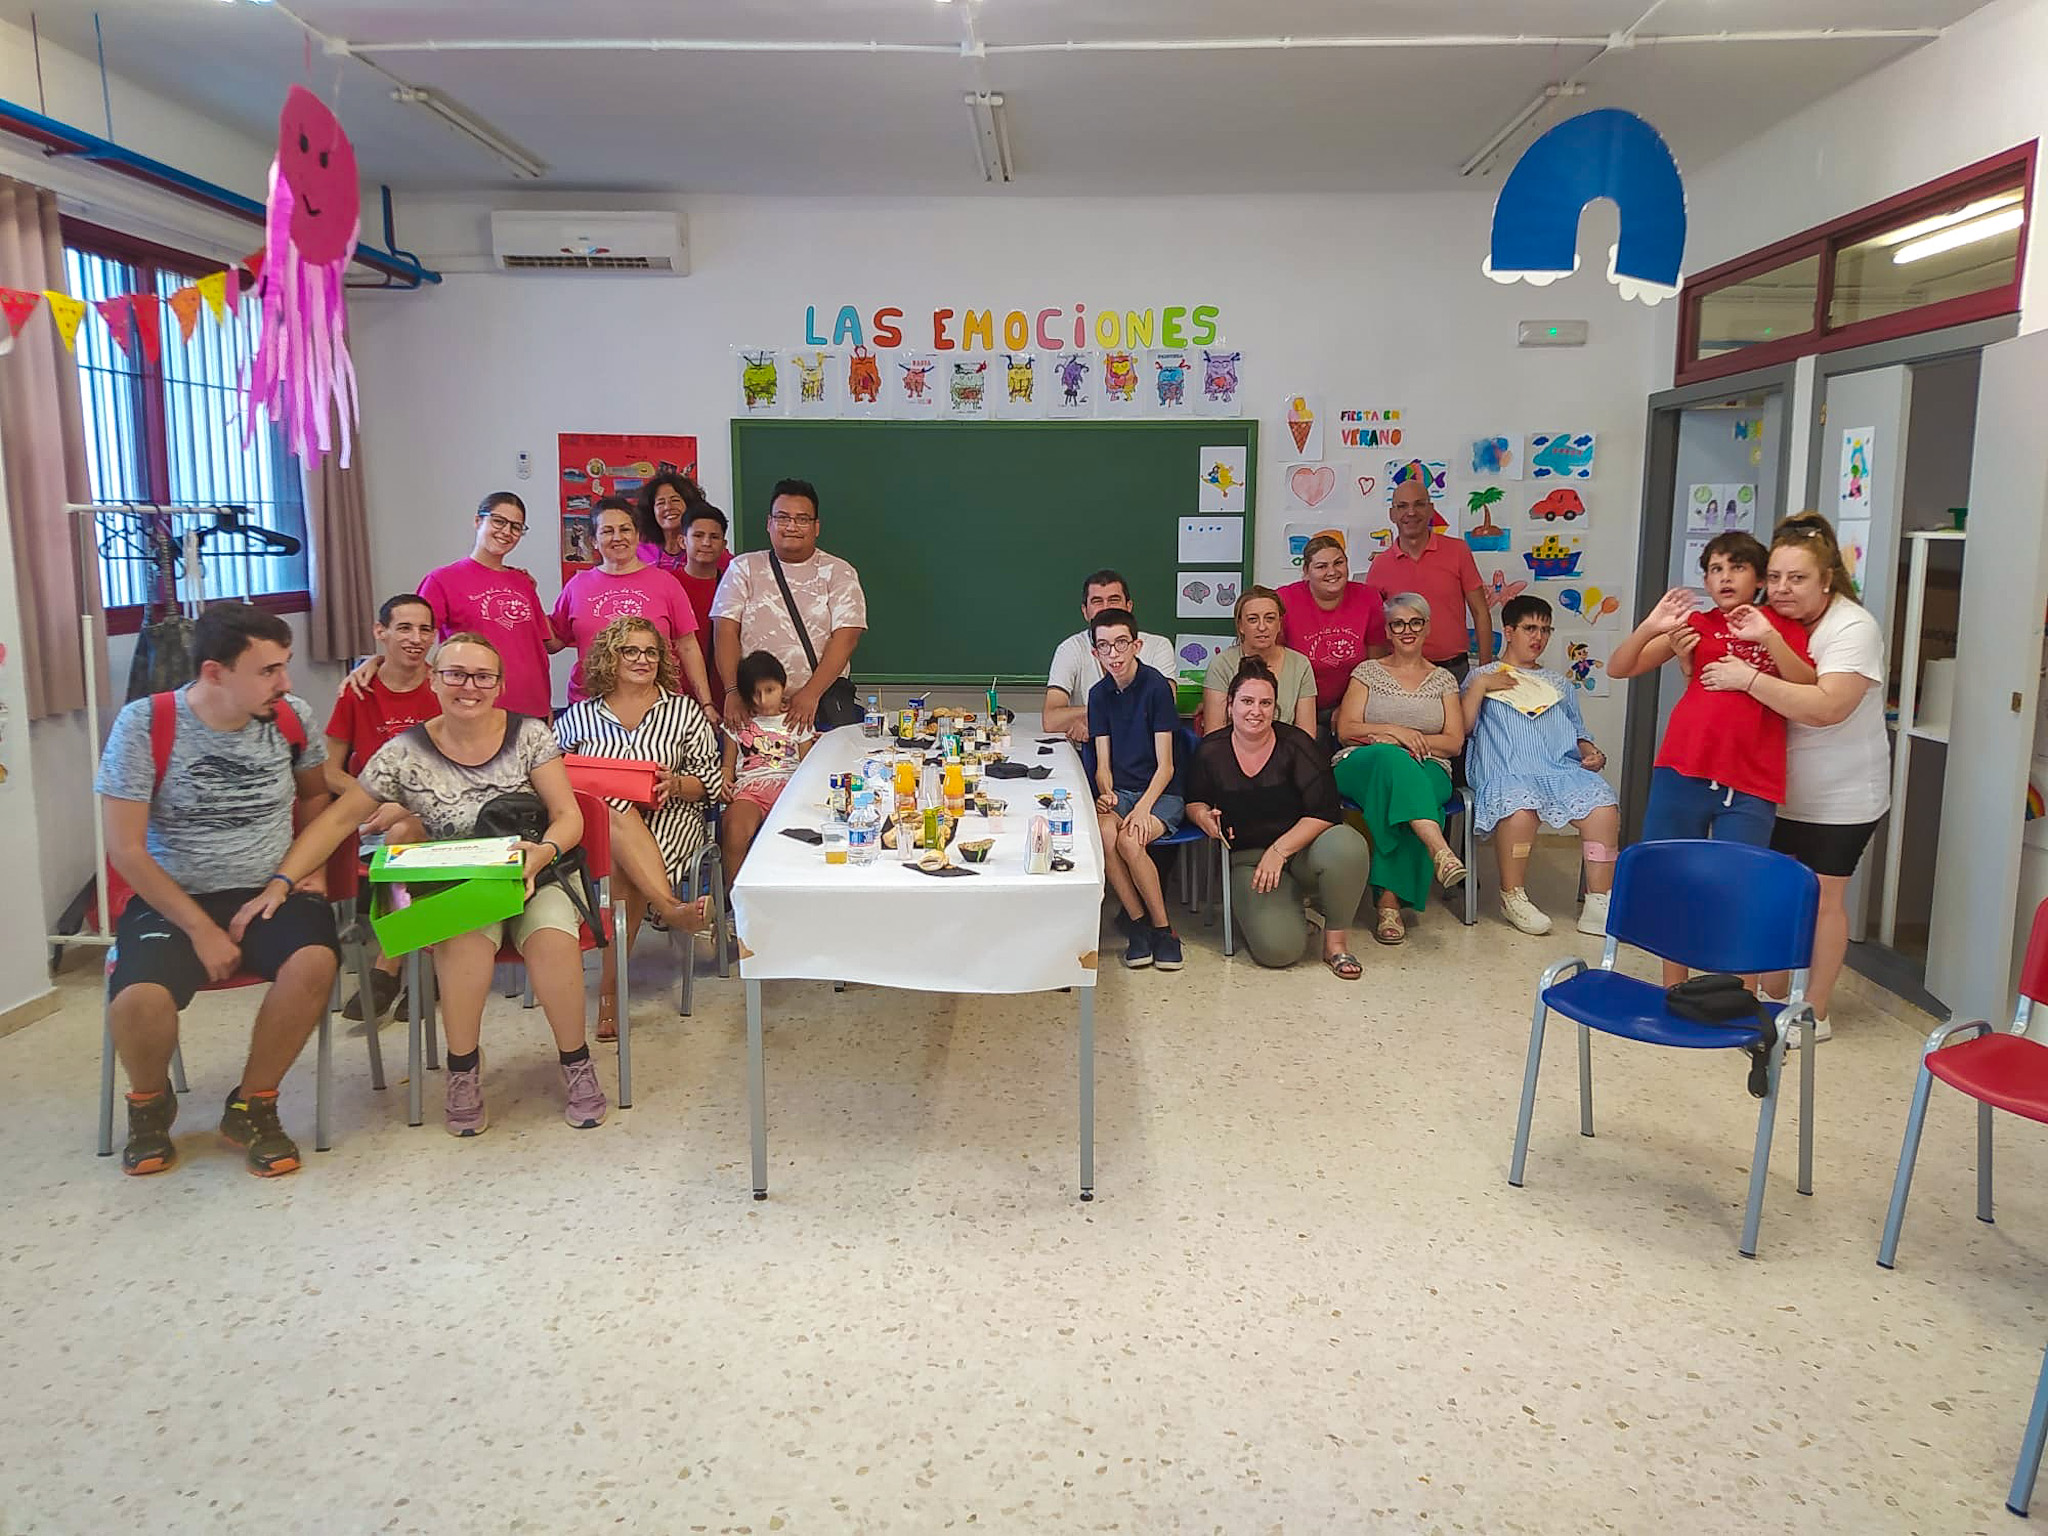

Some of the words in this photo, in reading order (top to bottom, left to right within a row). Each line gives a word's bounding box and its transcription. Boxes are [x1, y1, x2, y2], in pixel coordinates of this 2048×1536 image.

[805, 304, 904, 348] LAS
[1340, 410, 1379, 422] FIESTA
[1341, 427, 1402, 447] VERANO
